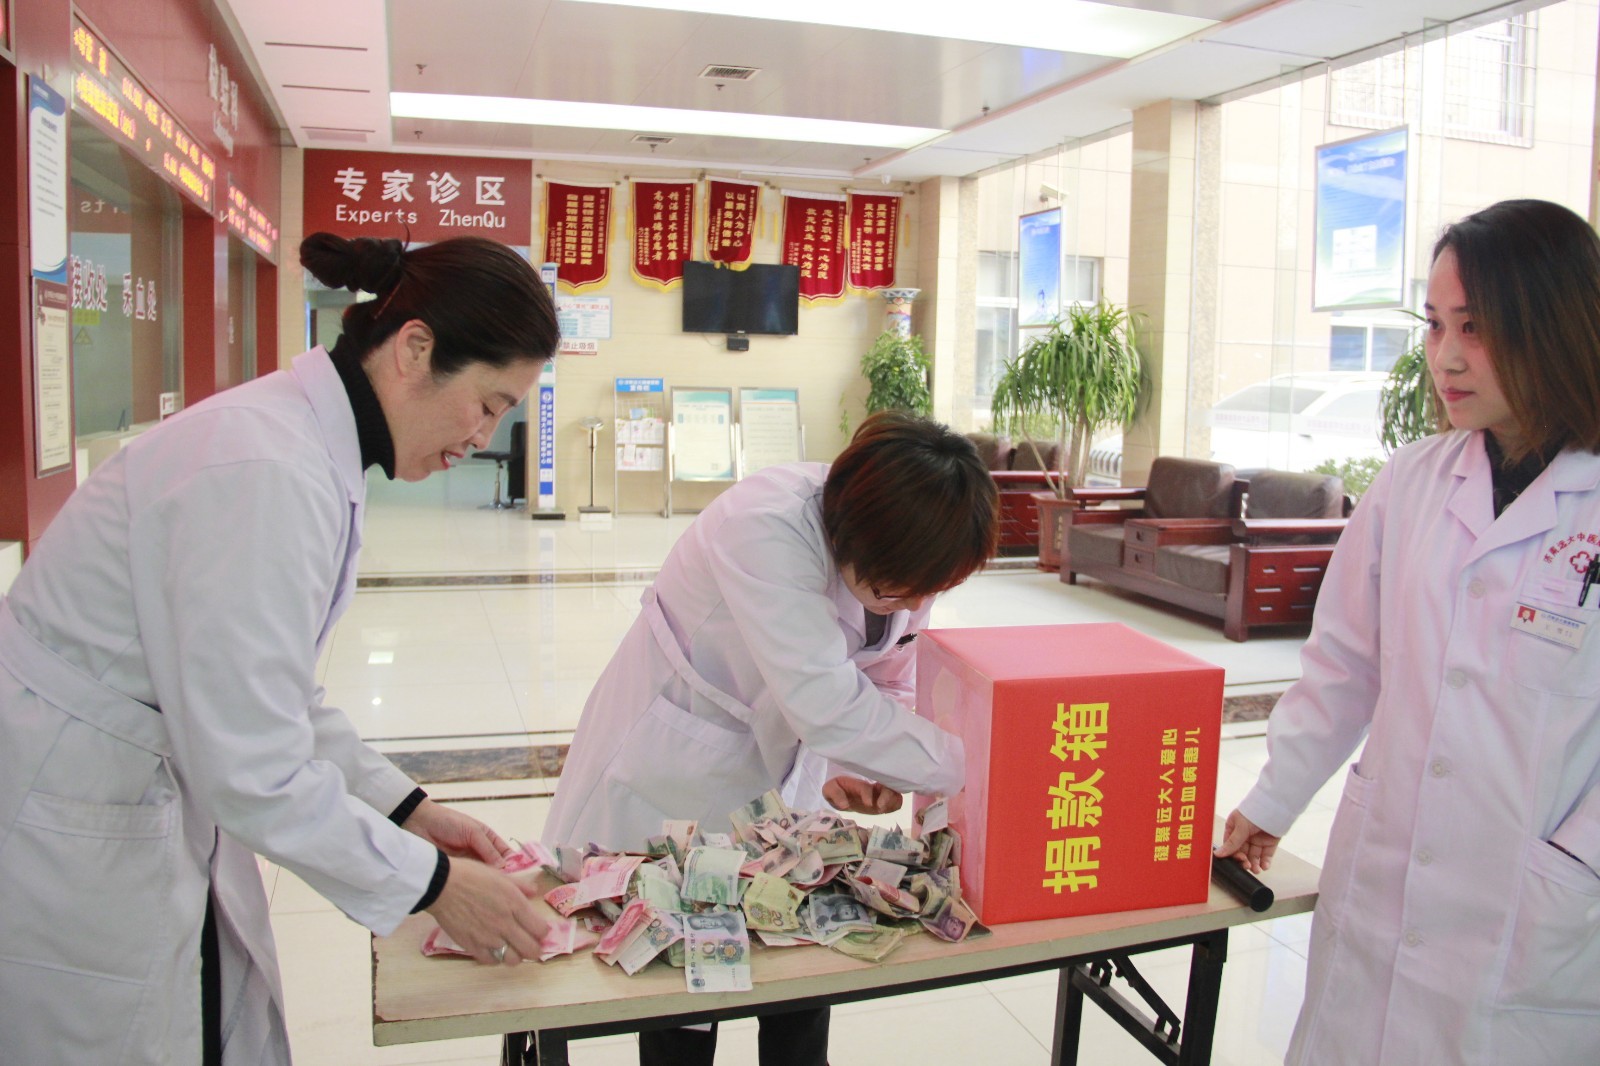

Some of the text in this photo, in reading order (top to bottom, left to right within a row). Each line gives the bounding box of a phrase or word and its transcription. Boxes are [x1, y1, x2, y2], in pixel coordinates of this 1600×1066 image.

[334, 167, 506, 206] 专家诊区
[336, 204, 506, 228] Experts ZhenQu
[732, 193, 747, 247] 以病人为中心
[123, 272, 157, 321] 采血处
[563, 341, 595, 350] 禁止吸烟
[1043, 702, 1109, 894] 捐款箱
[1154, 728, 1178, 862] 凝聚远大人爱心
[1176, 727, 1201, 860] 救助白血病患儿
[702, 941, 715, 962] 10
